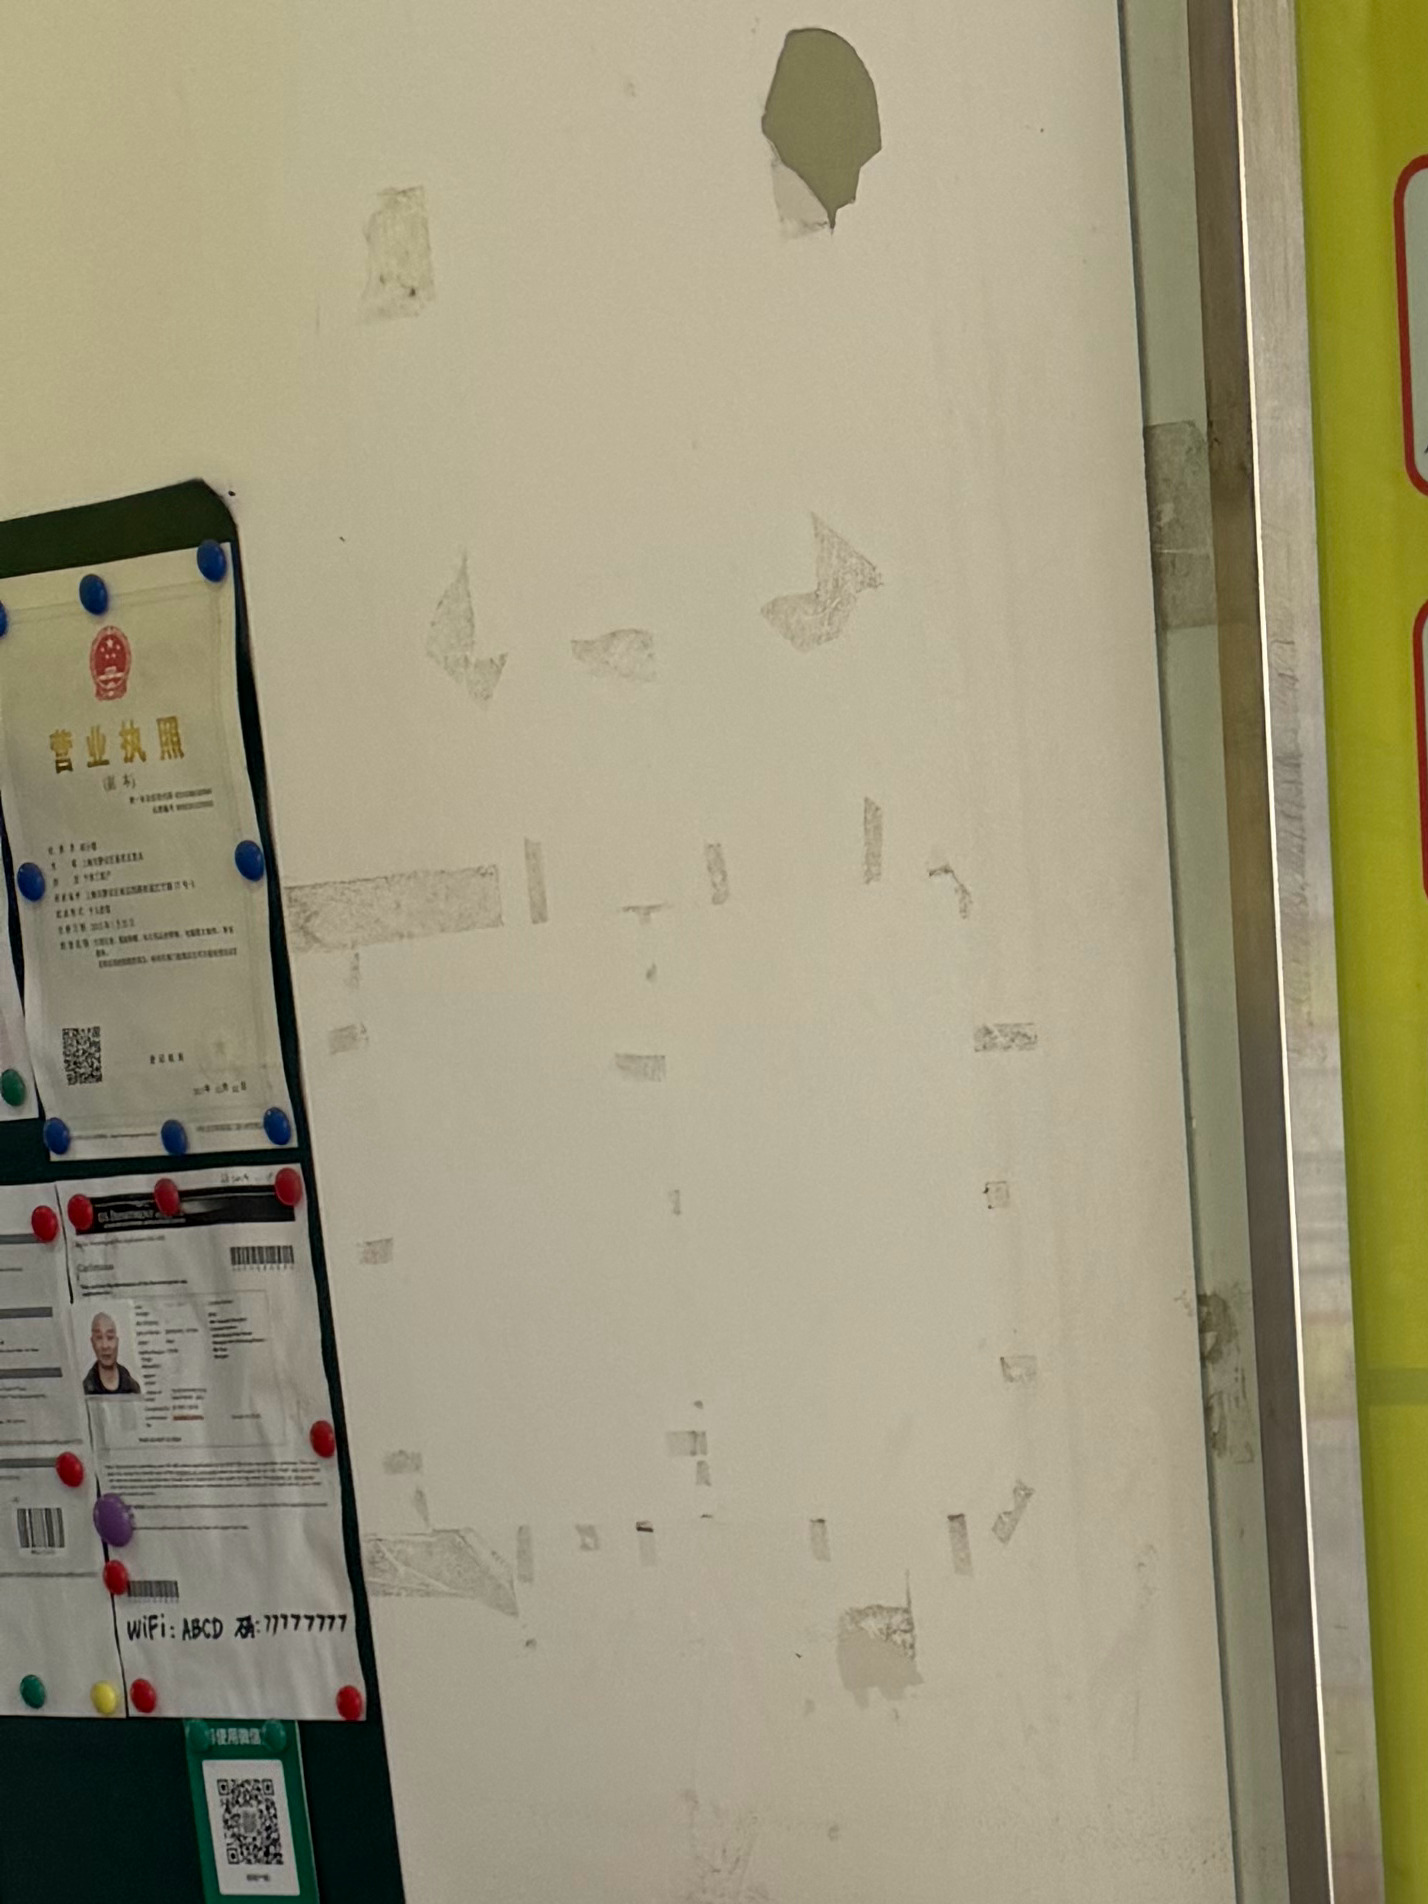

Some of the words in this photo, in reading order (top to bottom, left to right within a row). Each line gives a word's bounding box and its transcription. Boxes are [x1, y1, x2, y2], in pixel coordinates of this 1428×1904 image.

[50, 716, 185, 774] 营业执照
[182, 1617, 223, 1641] ABCD
